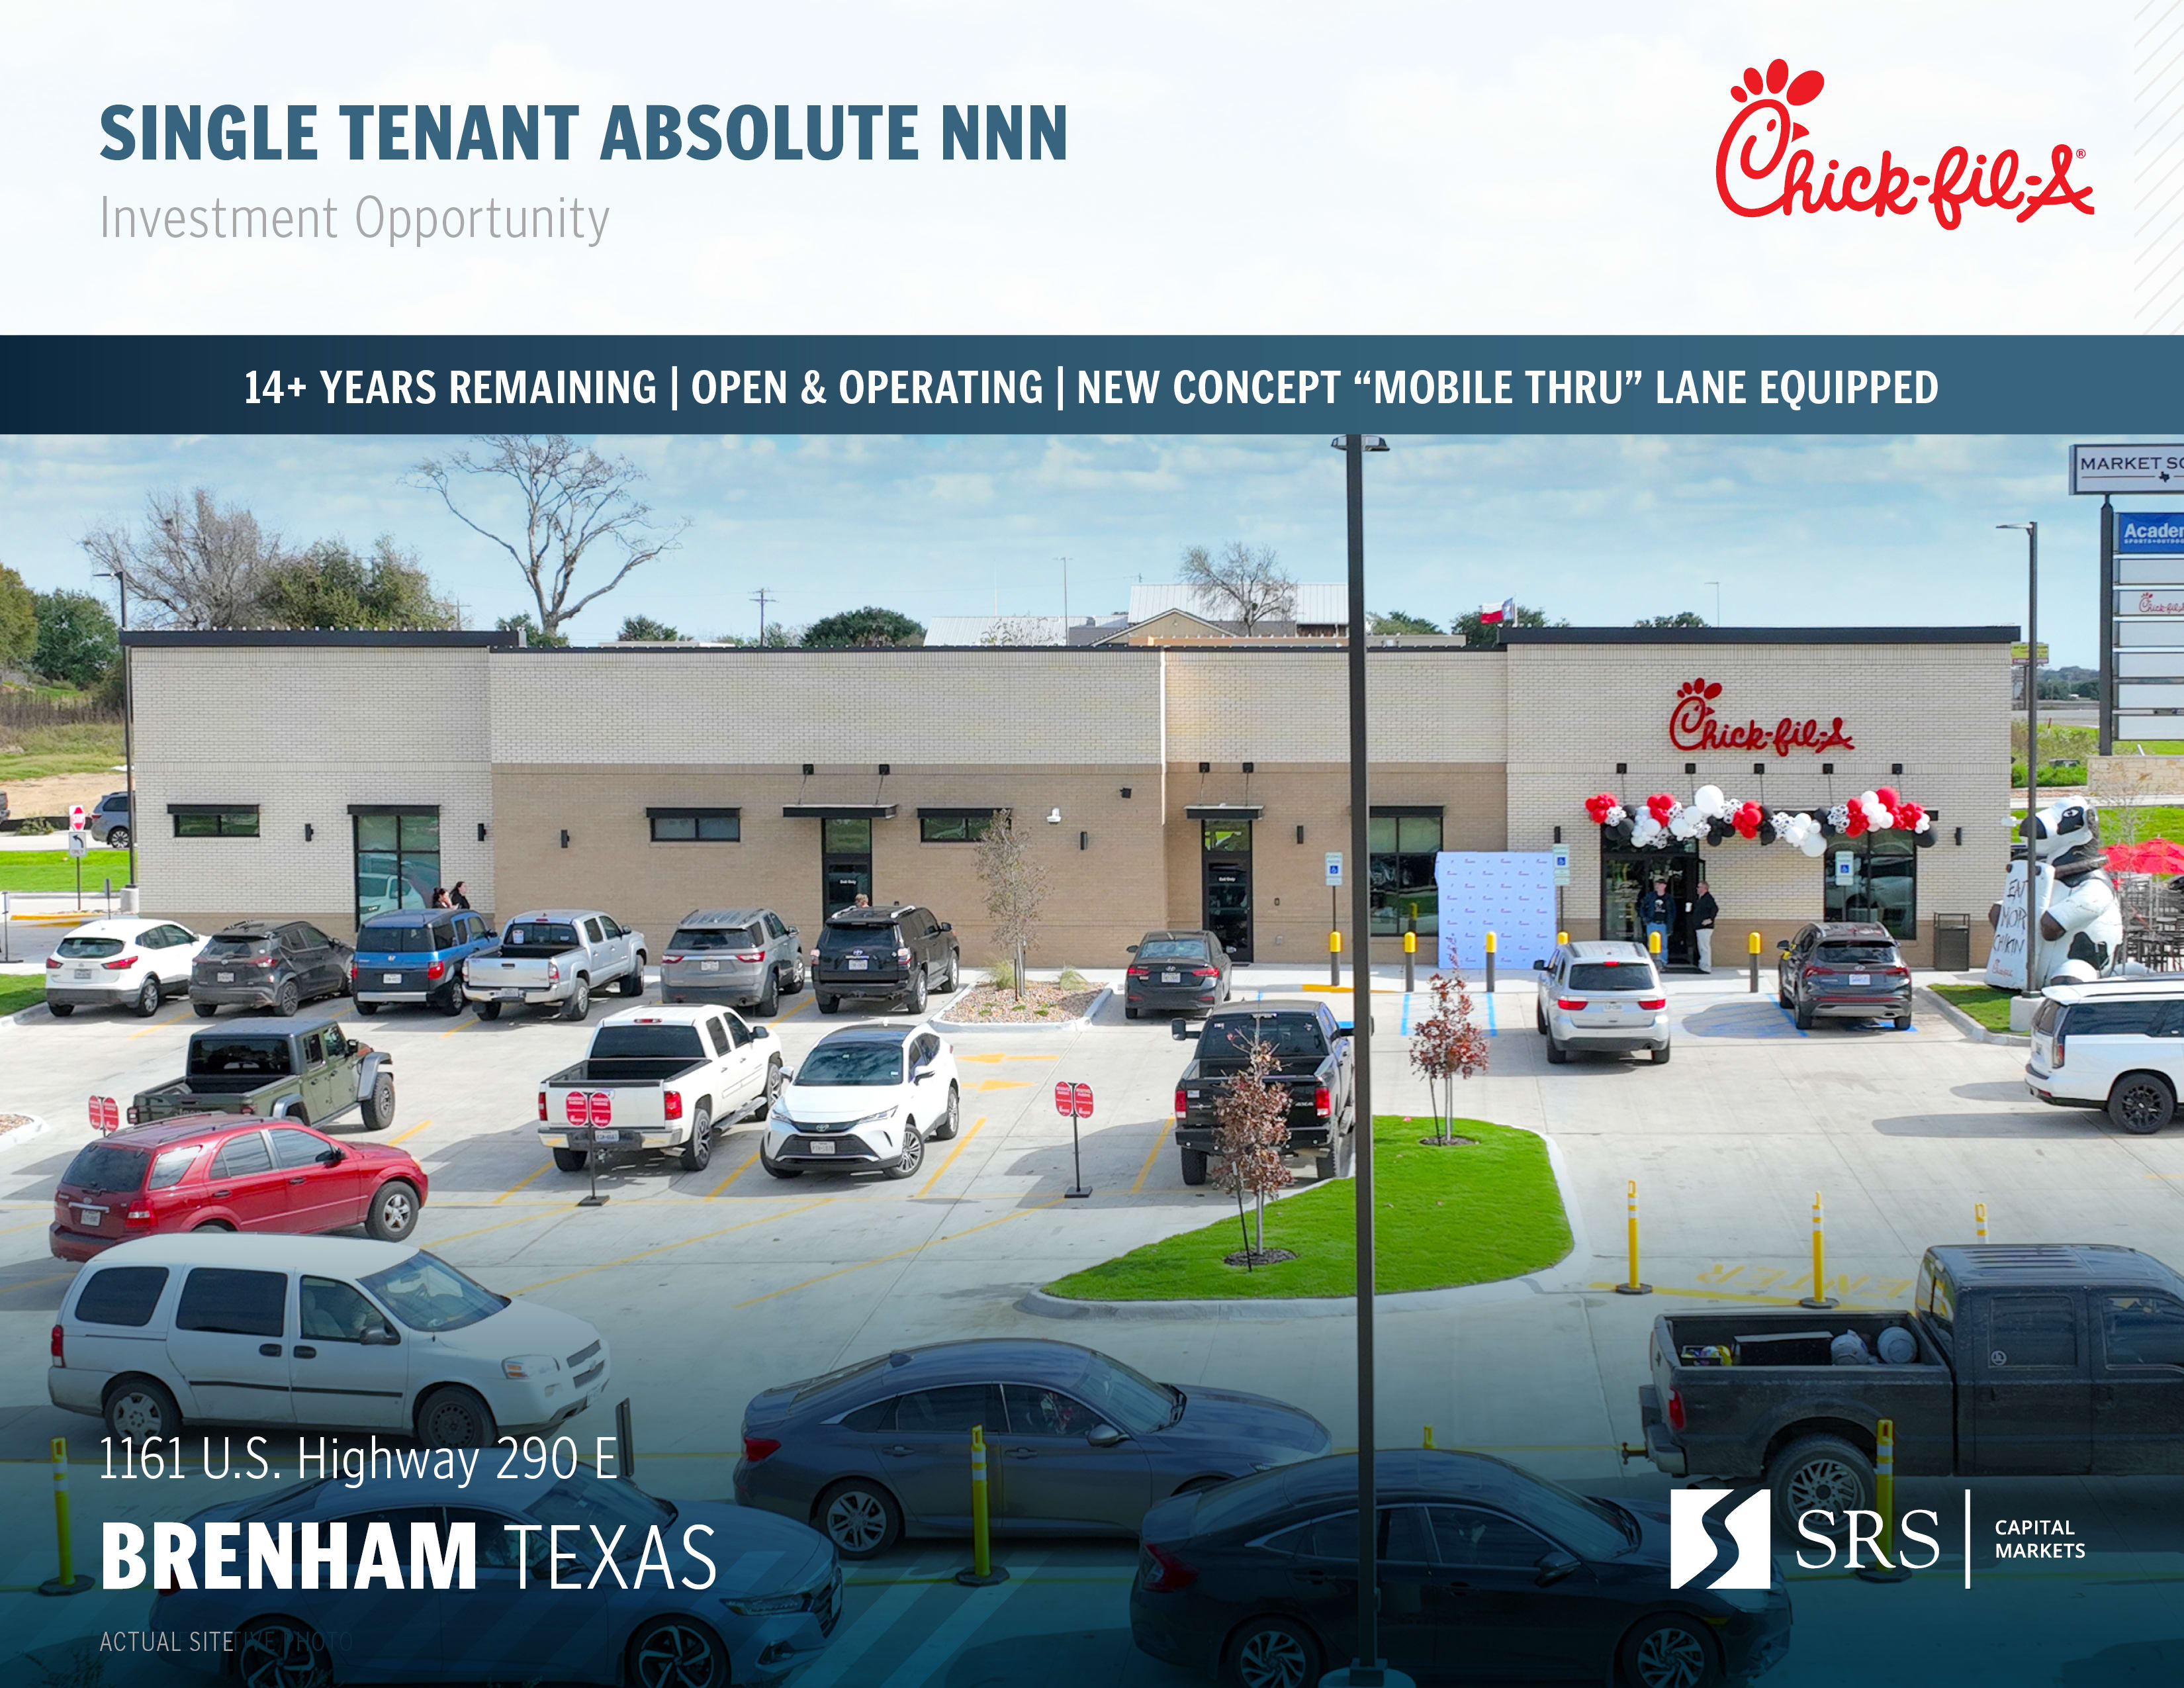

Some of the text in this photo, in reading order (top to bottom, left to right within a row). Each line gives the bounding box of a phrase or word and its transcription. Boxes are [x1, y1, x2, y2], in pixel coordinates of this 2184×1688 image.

[2081, 457, 2162, 470] MARKET
[1669, 678, 1855, 757] Chick-fil-A
[2007, 878, 2028, 903] EAT
[2001, 906, 2028, 931] MOR
